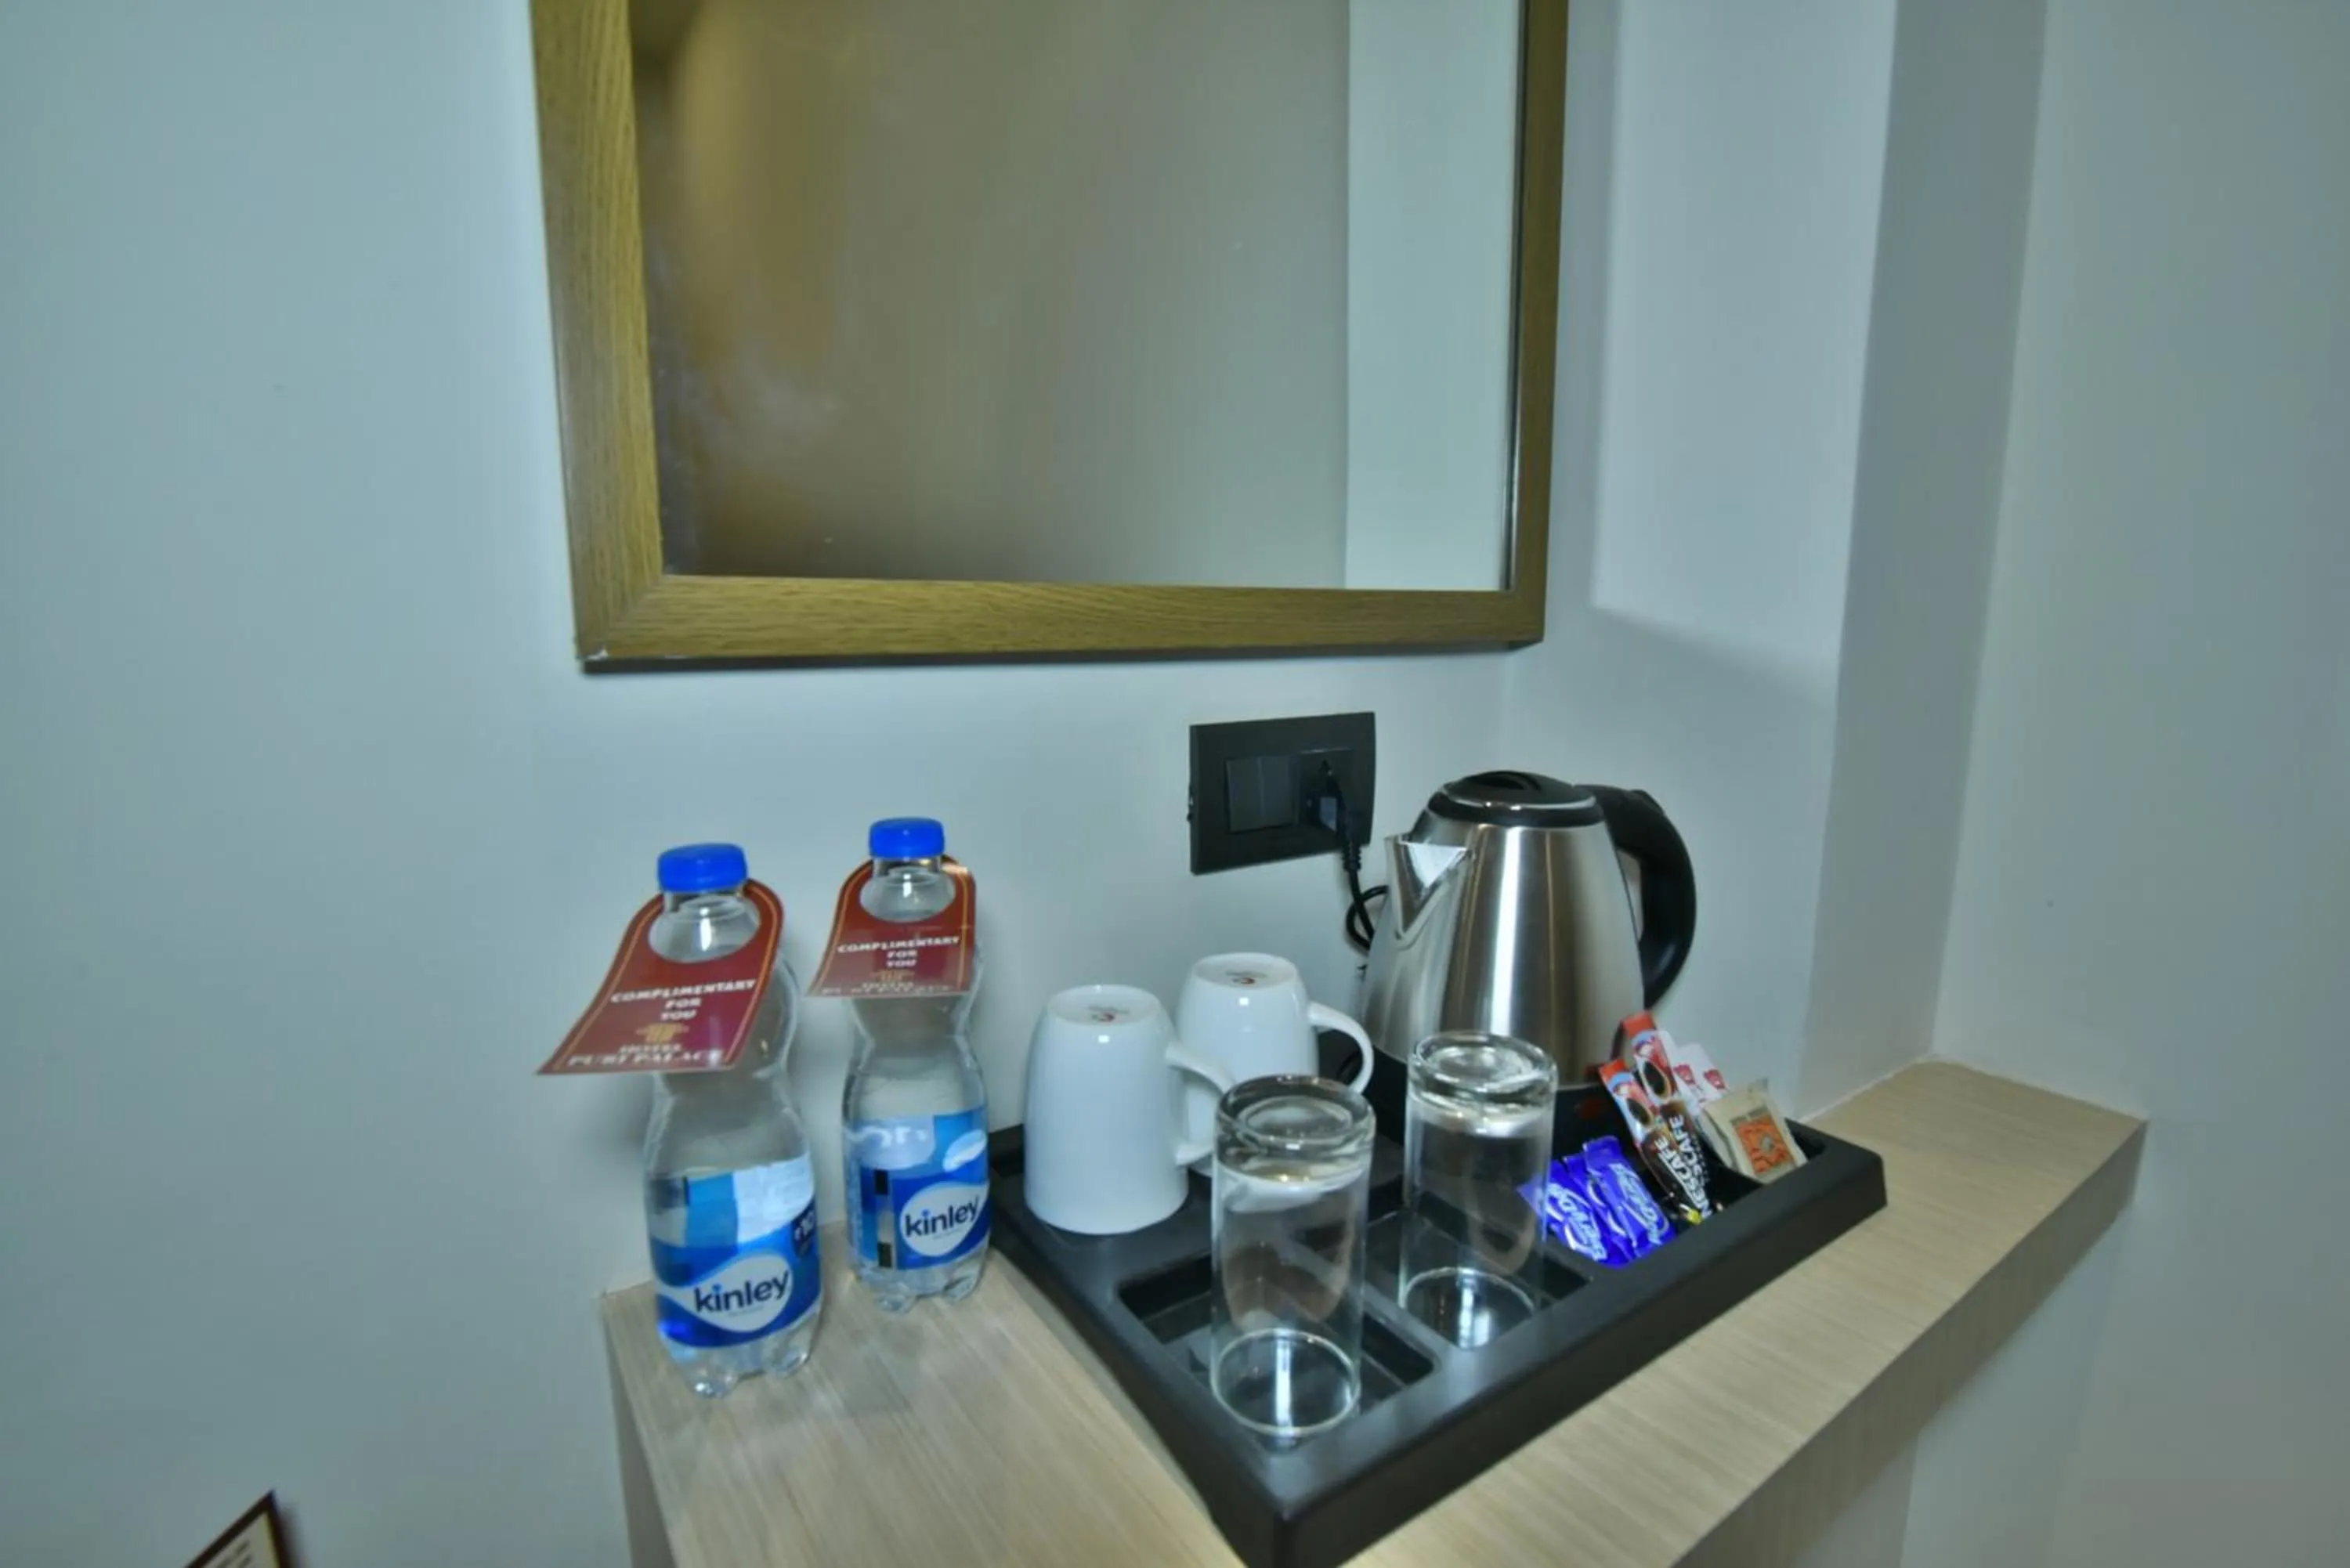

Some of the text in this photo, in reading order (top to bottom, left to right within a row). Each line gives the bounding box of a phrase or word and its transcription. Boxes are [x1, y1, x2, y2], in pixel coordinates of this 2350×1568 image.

[837, 937, 960, 953] COMPLIMENTARY
[886, 949, 918, 959] FOR
[885, 959, 917, 968] YOU
[610, 979, 757, 1003] COMPLIMENTARY
[664, 997, 702, 1010] FOR
[660, 1009, 698, 1021] YOU
[906, 1194, 979, 1237] kinley
[694, 1270, 789, 1312] kinley
